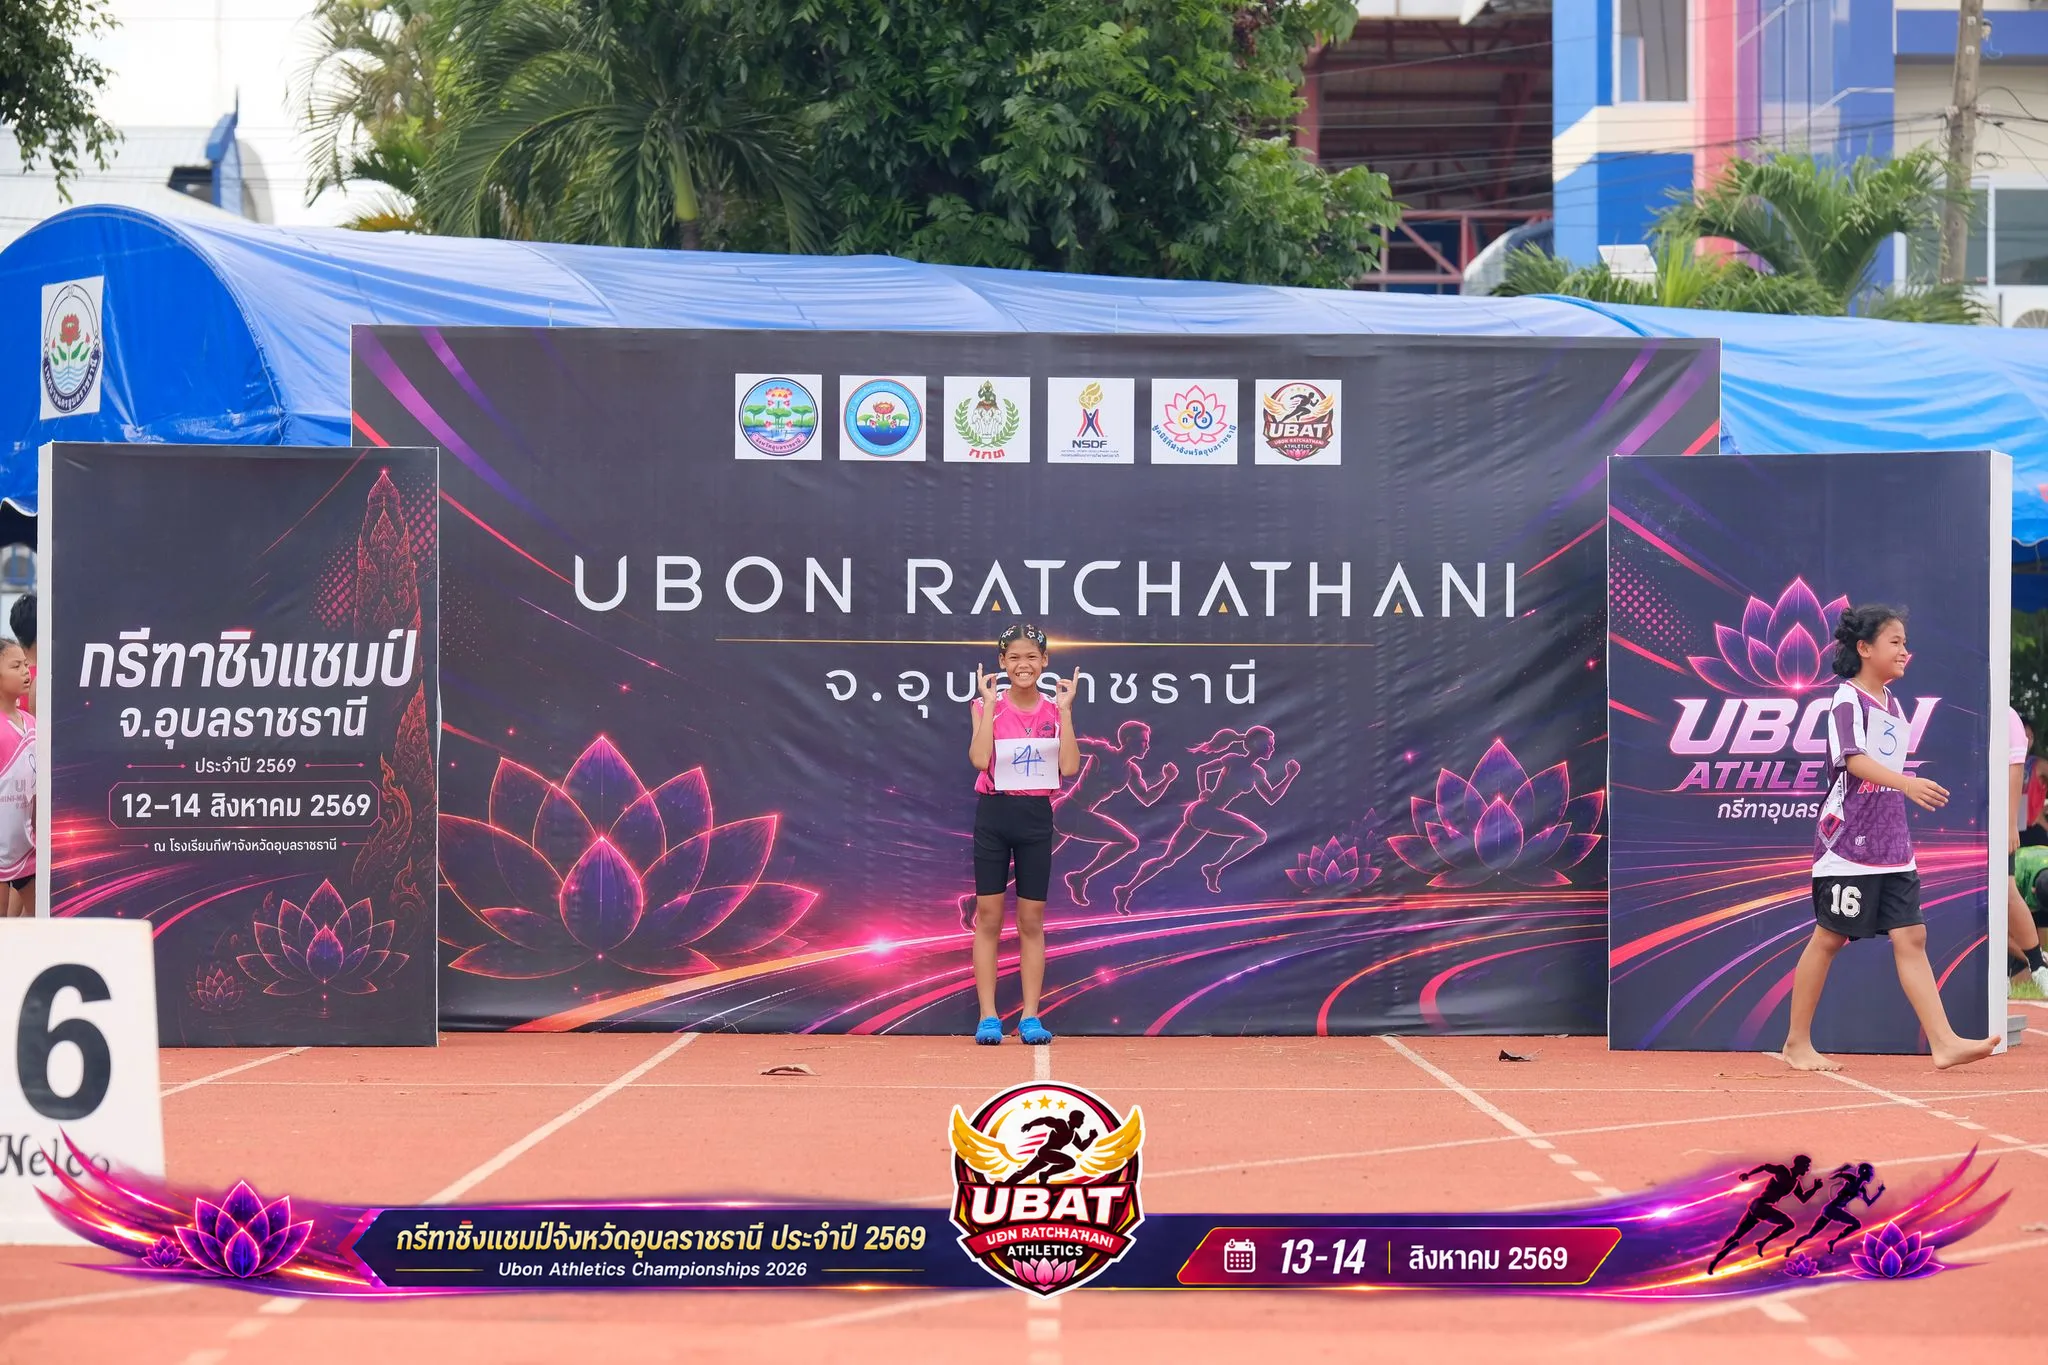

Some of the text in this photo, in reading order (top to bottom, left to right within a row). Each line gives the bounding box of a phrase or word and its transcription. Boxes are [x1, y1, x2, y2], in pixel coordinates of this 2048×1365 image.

[1072, 440, 1108, 449] NSDF
[1269, 423, 1328, 438] UBAT
[968, 447, 1006, 460] กกท
[574, 555, 1515, 618] UBON RATCHATHANI
[79, 627, 417, 688] กรีฑาชิงแชมป์
[119, 695, 368, 750] จ.อุบลราชธานี
[1878, 720, 1899, 757] 3
[195, 756, 297, 774] ประจำปี 2569
[210, 792, 301, 818] สิงหาคม
[310, 794, 371, 818] 2569
[153, 837, 337, 855] ณ โรงเรียนกีฬาจังหวัดอุบลราชธานี
[1830, 883, 1862, 918] 16
[16, 963, 111, 1121] 6
